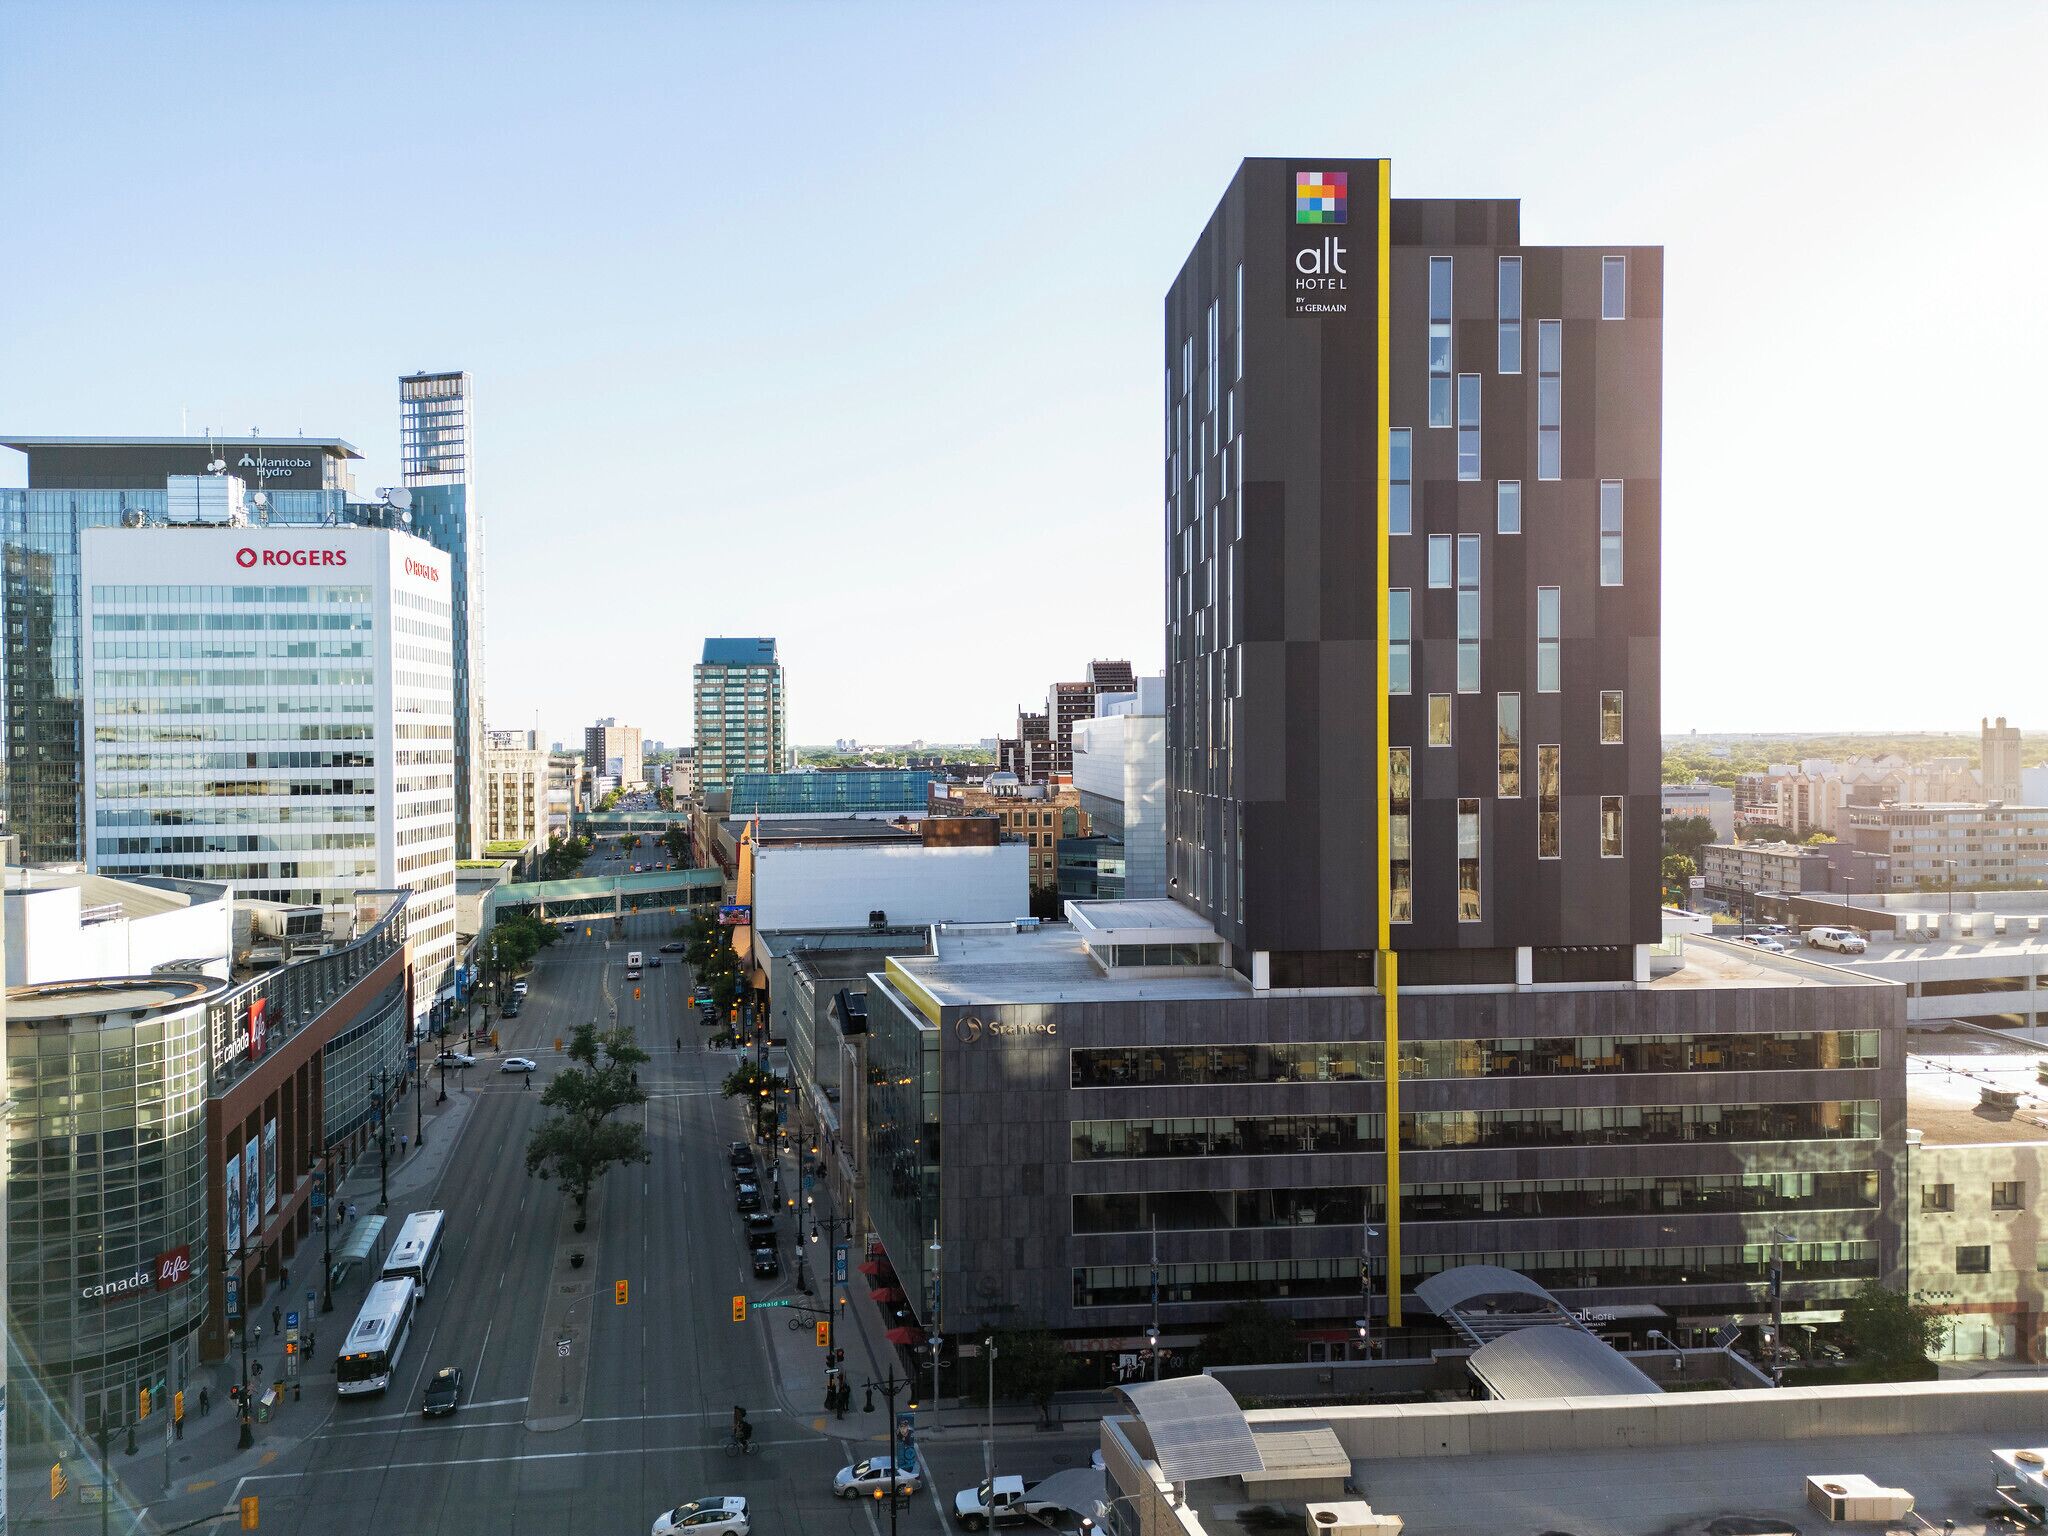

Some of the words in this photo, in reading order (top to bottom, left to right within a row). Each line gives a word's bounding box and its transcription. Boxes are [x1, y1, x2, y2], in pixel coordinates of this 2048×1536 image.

[1295, 236, 1347, 274] alt
[1295, 278, 1347, 290] HOTEL
[1305, 304, 1347, 312] GERMAIN
[256, 456, 312, 468] Manitoba
[256, 467, 292, 478] Hydro
[262, 549, 347, 566] ROGERS
[988, 1021, 1057, 1036] Stantec
[224, 1028, 250, 1064] canada
[251, 1012, 266, 1050] life
[82, 1270, 150, 1299] canada
[158, 1255, 191, 1282] life
[1573, 1308, 1591, 1321] alt
[1592, 1312, 1616, 1321] HOTEL
